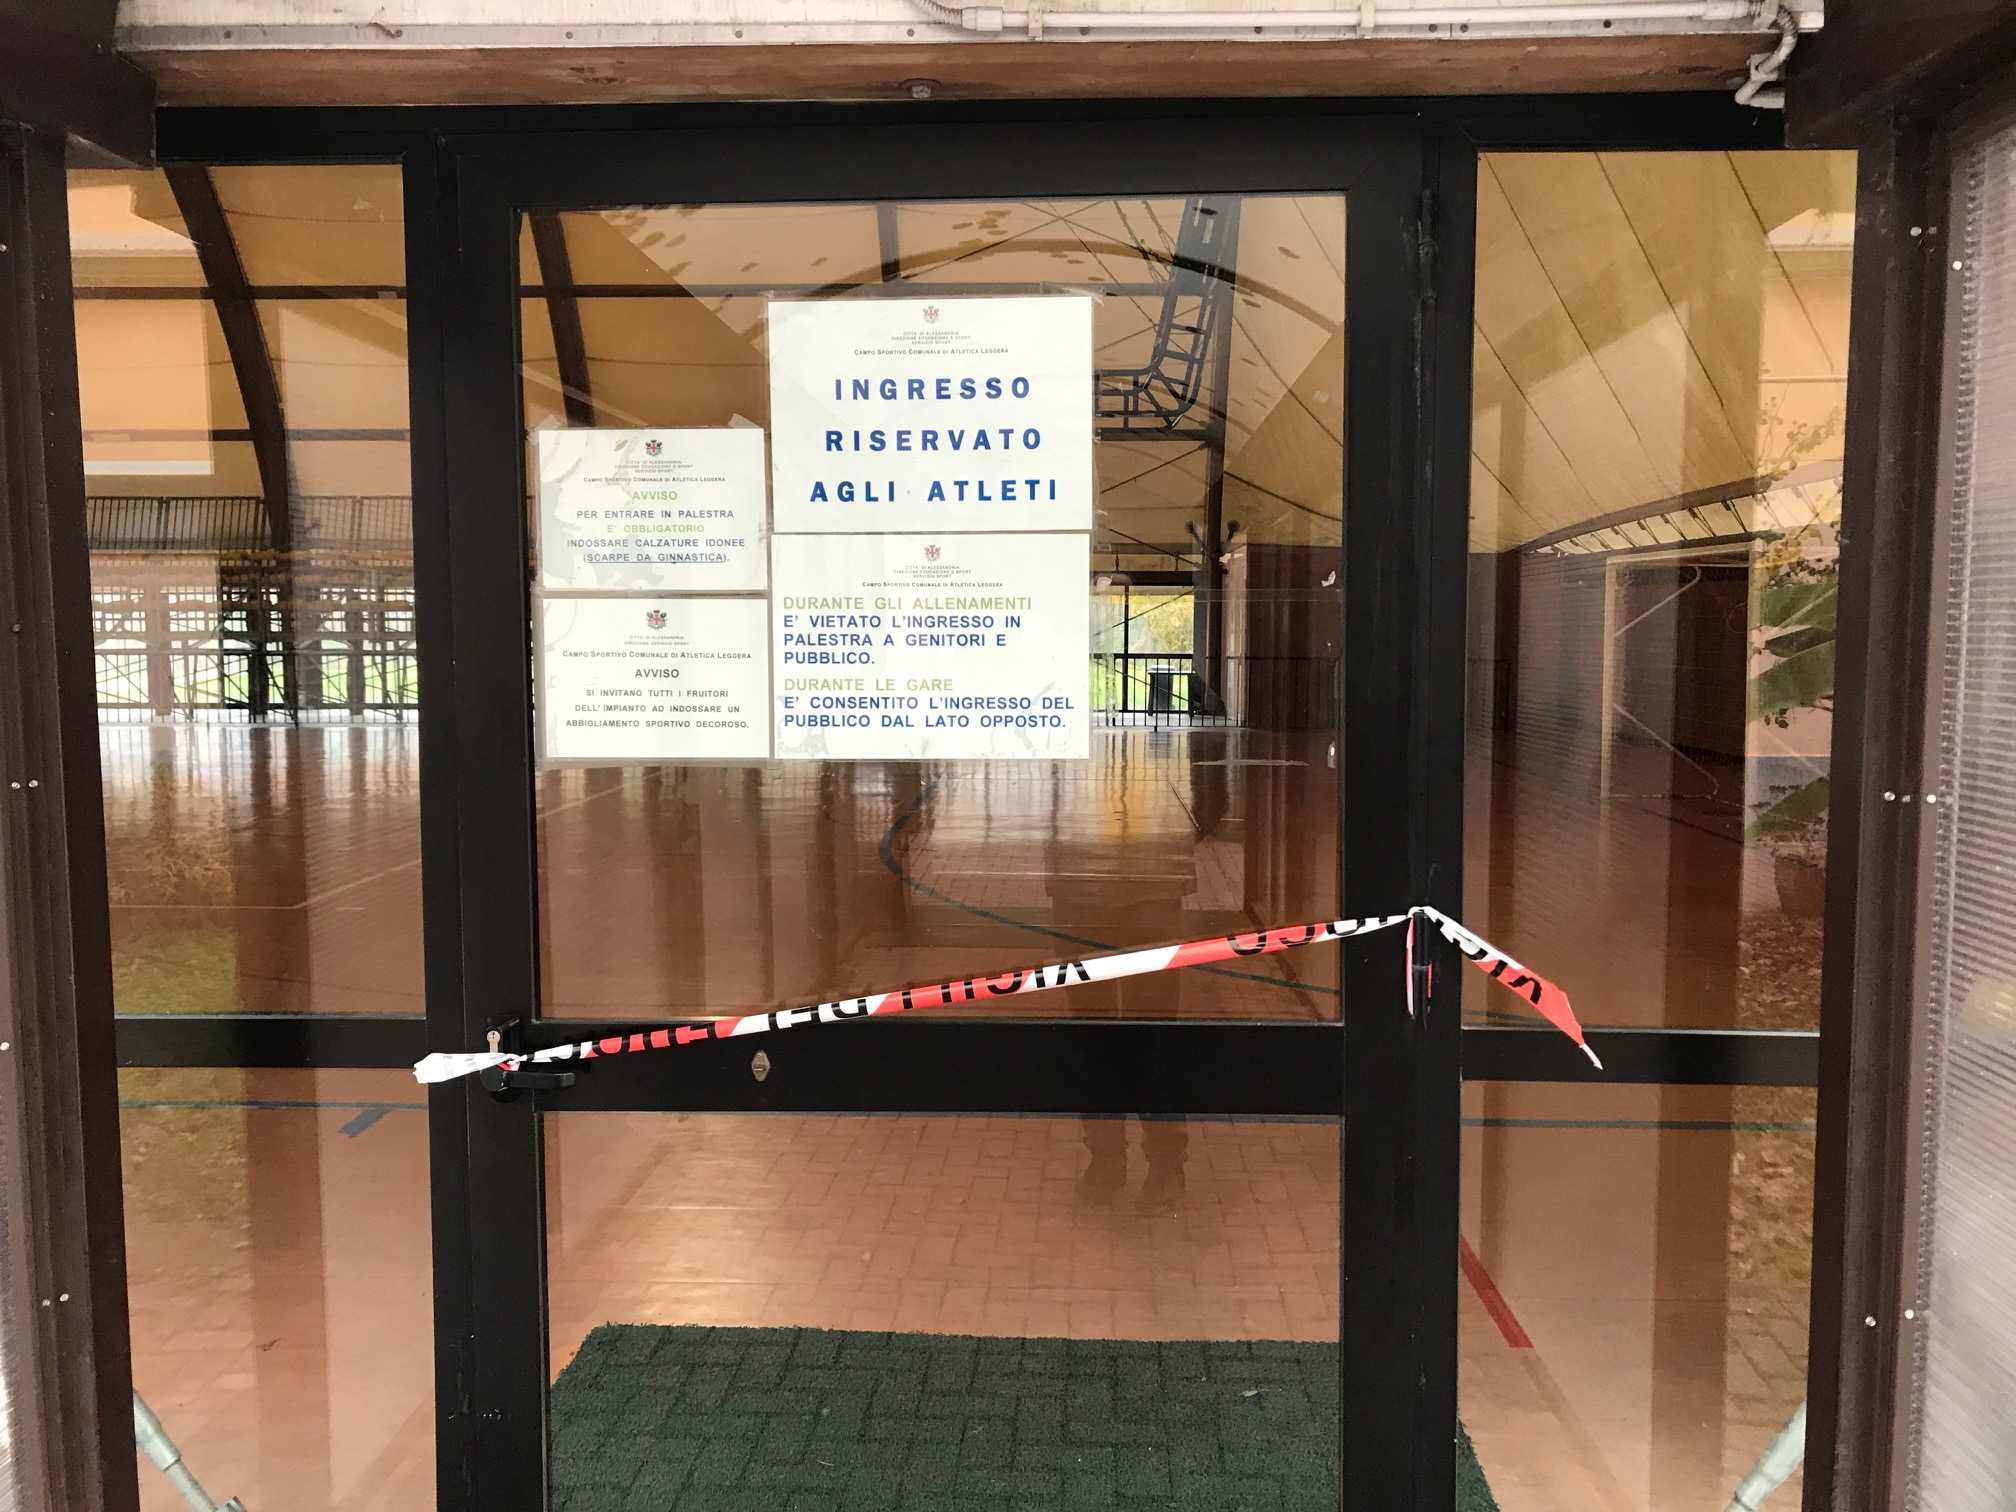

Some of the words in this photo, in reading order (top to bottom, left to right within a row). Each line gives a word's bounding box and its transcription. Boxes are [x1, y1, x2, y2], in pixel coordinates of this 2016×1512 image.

[835, 377, 1030, 401] INGRESSO
[826, 428, 1041, 452] RISERVATO
[632, 491, 678, 501] AVVISO
[810, 481, 895, 502] AGLI
[928, 479, 1056, 501] ATLETI
[577, 511, 598, 519] PER
[605, 510, 654, 519] ENTRARE
[661, 511, 671, 519] IN
[678, 510, 734, 519] PALESTRA
[624, 524, 705, 533] OBBLIGATORIO
[567, 539, 629, 547] INDOSSARE
[635, 539, 699, 547] CALZATURE
[705, 539, 745, 547] IDONEE
[584, 553, 630, 563] (SCARPE
[637, 553, 651, 562] DA
[658, 553, 730, 563] GINNASTICA).
[784, 597, 864, 610] DURANTE
[875, 597, 902, 610] GLI
[913, 597, 1032, 610] ALLENAMENTI
[810, 615, 882, 628] VIETATO
[1005, 616, 1021, 628] IN
[784, 634, 873, 647] PALESTRA
[884, 634, 895, 646] A
[906, 634, 986, 647] GENITORI
[997, 634, 1006, 646] E
[784, 652, 875, 665] PUBBLICO.
[635, 669, 680, 678] AVVISO
[784, 678, 864, 691] DURANTE
[876, 679, 895, 691] LE
[907, 678, 954, 691] GARE
[652, 705, 664, 713] AD
[670, 705, 721, 713] INDOSSARE
[810, 696, 919, 709] CONSENTITO
[1042, 697, 1075, 709] DEL
[566, 720, 640, 728] ABBIGLIAMENTO
[646, 720, 691, 728] SPORTIVO
[696, 720, 749, 728] DECOROSO.
[784, 714, 871, 728] PUBBLICO
[882, 715, 914, 728] DAL
[925, 715, 970, 728] LATO
[980, 714, 1066, 728] OPPOSTO.
